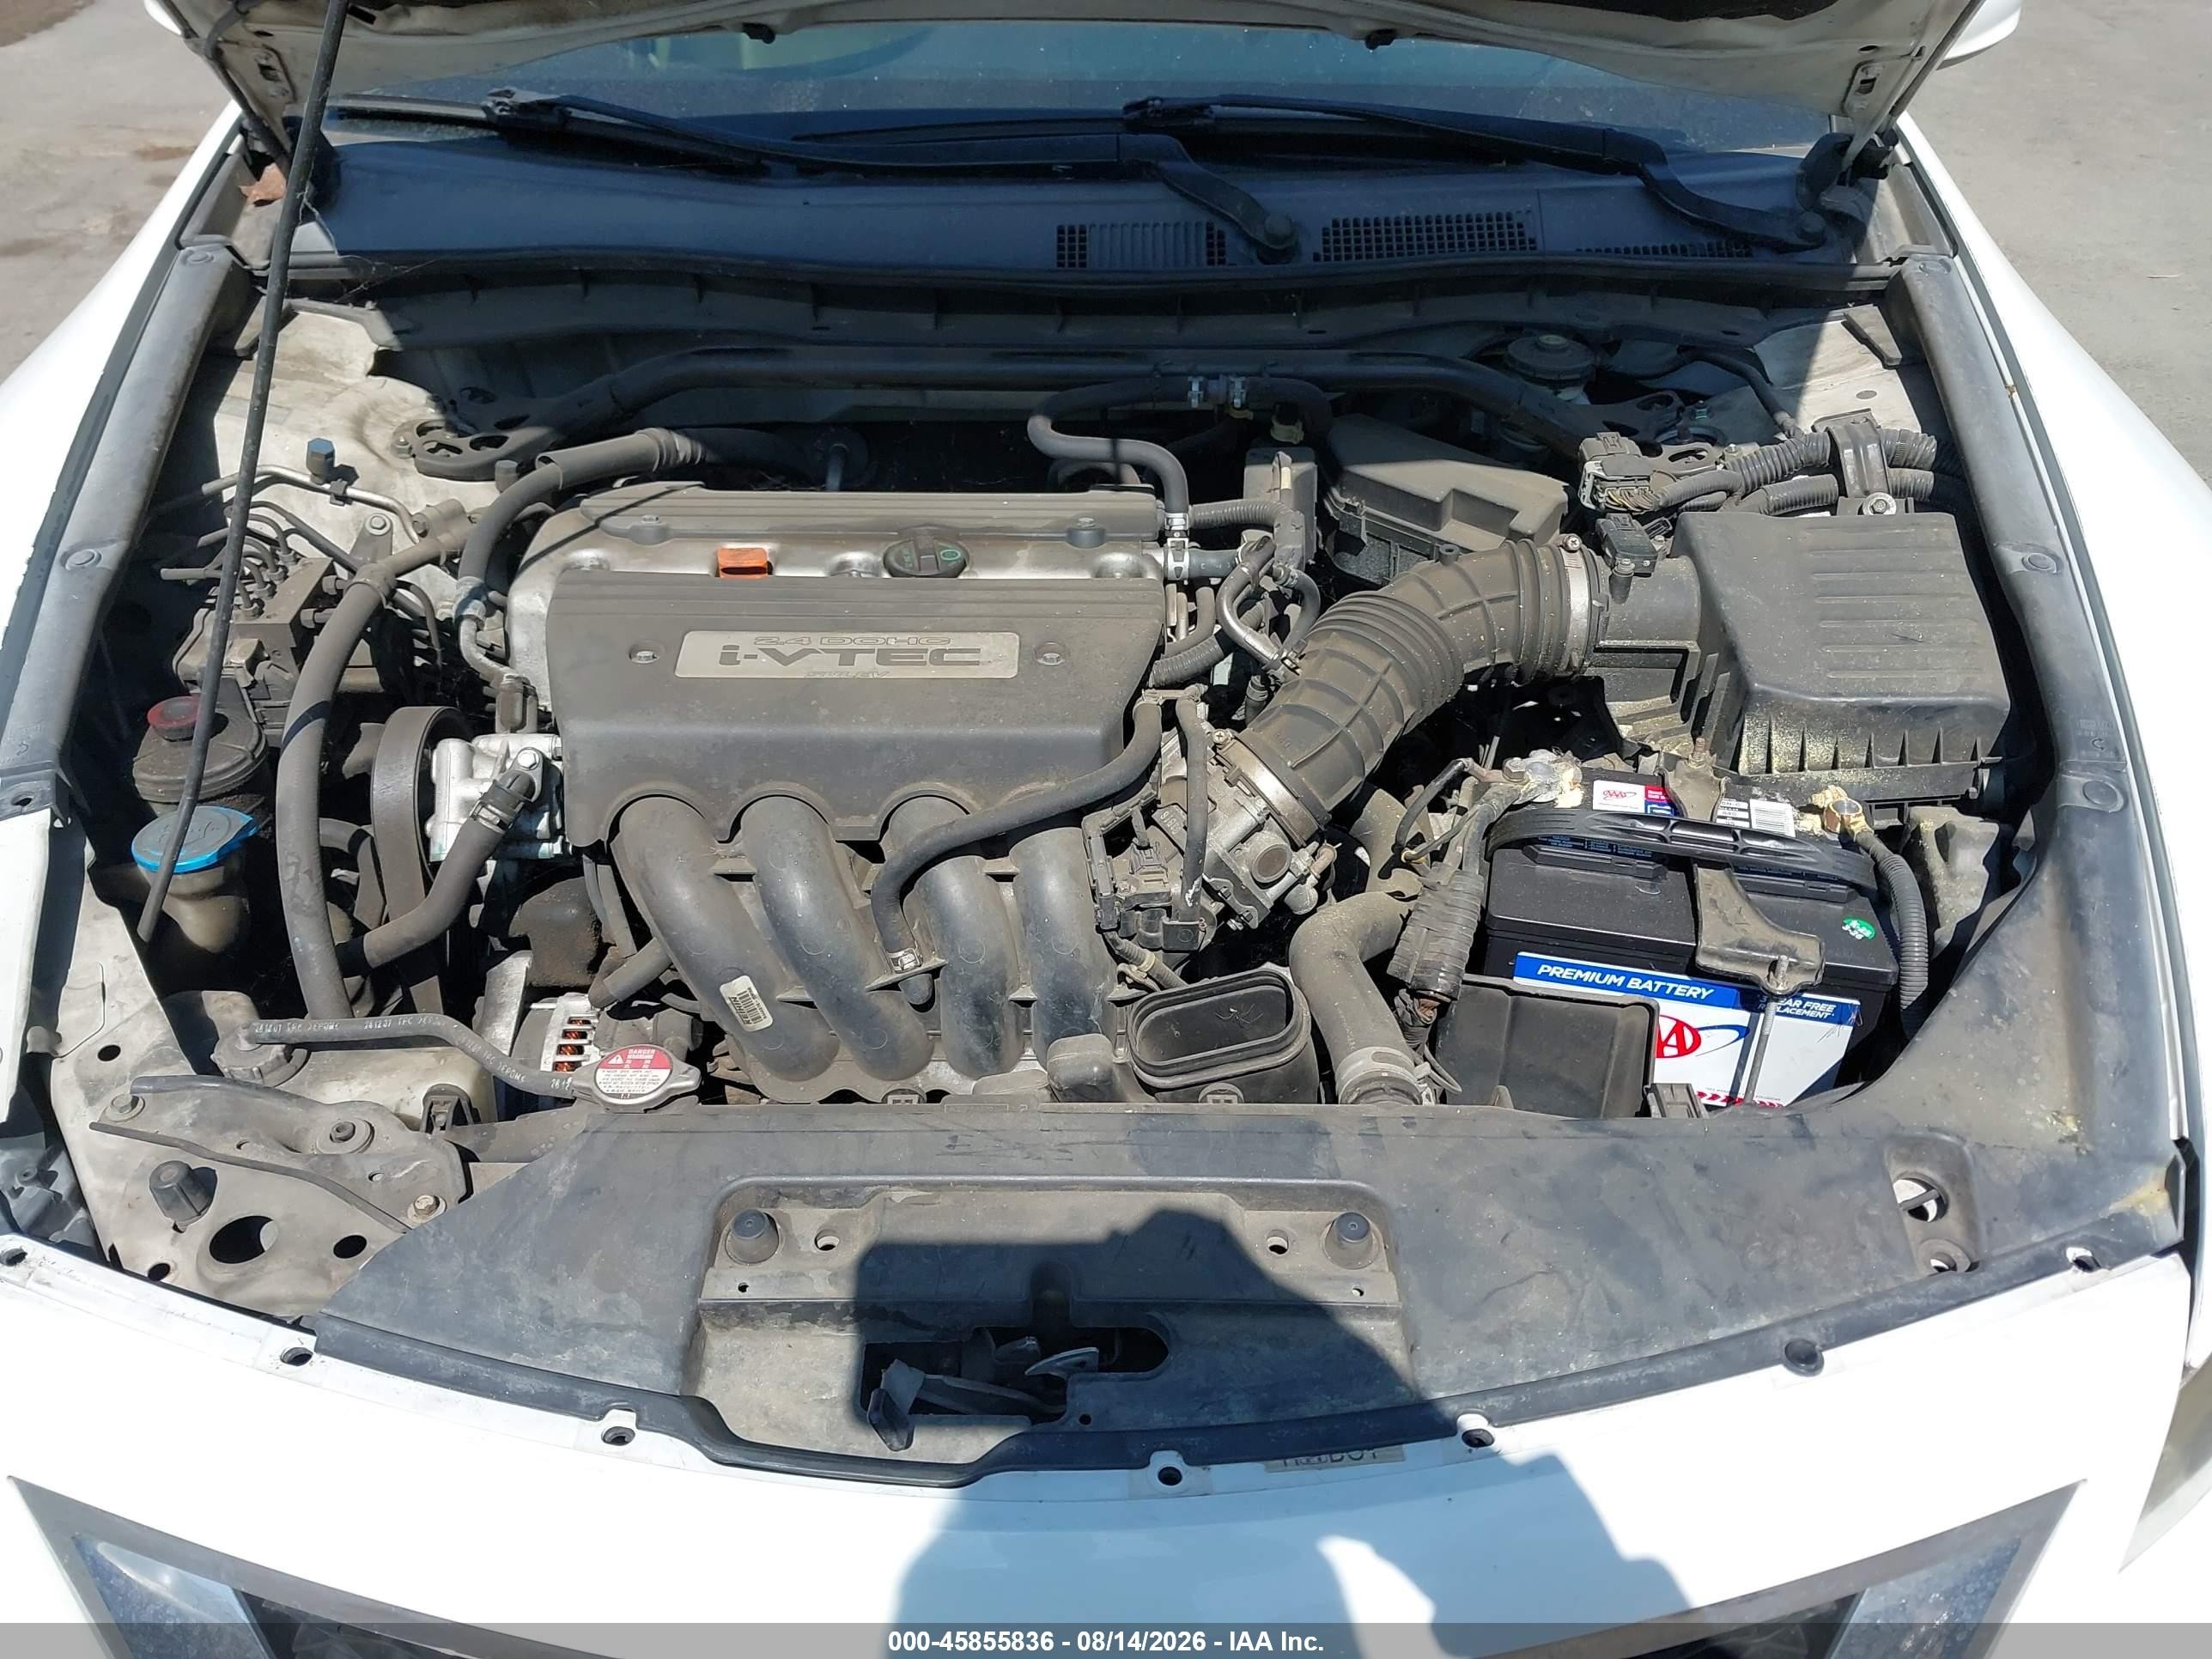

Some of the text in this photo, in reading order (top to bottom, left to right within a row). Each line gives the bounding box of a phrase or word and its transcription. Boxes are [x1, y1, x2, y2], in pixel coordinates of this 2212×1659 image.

[753, 636, 951, 646] 2.4 DOHC
[719, 644, 981, 666] i-VTEC
[1537, 964, 1715, 1000] PREMIUM BATTERY
[728, 996, 752, 1024] KEIHIN
[1803, 1001, 1837, 1013] FREE
